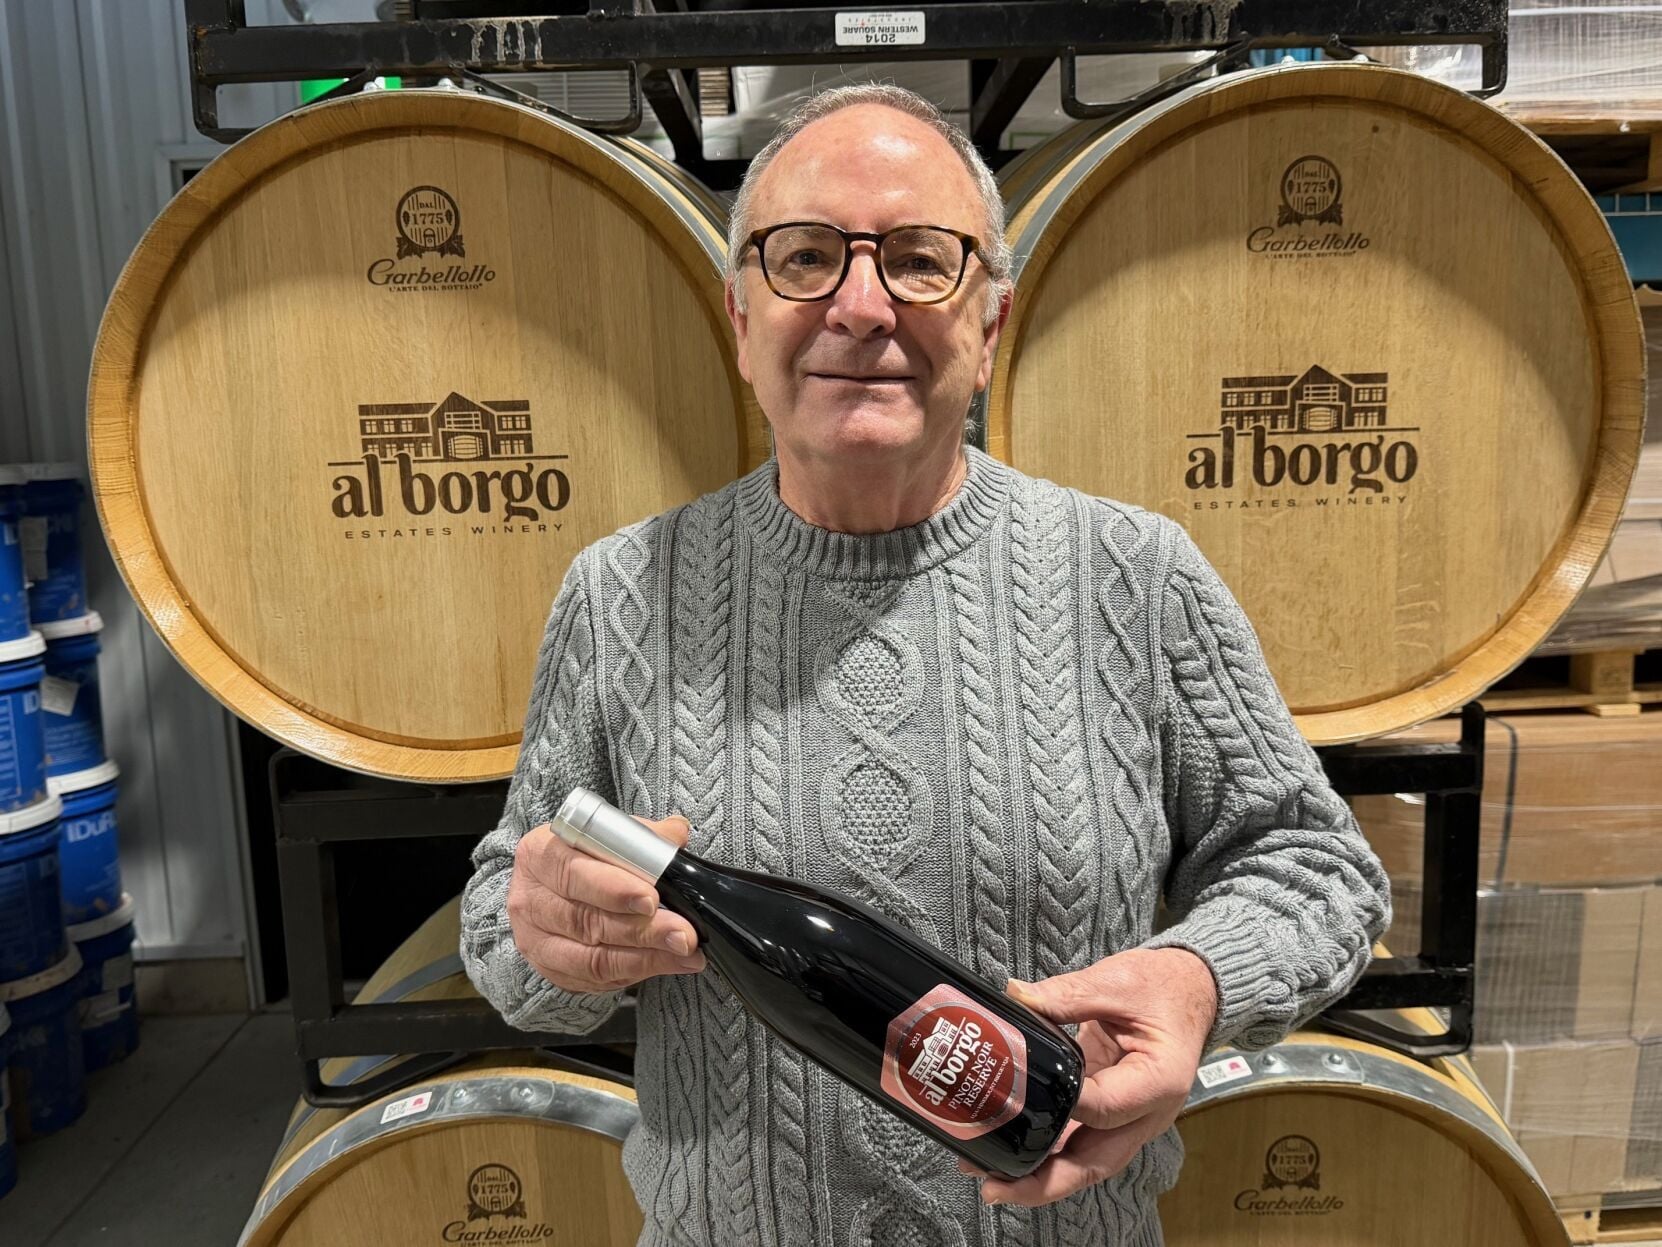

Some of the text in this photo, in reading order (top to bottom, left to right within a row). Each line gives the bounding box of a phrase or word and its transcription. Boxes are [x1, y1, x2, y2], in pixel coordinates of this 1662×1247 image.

[843, 26, 876, 34] SQUARE
[866, 34, 896, 43] 2014
[1296, 182, 1327, 194] 1775
[412, 213, 444, 225] 1775
[1185, 425, 1418, 494] al borgo
[331, 452, 570, 522] al borgo
[1194, 495, 1407, 510] ESTATES WINERY
[345, 524, 563, 539] ESTATES WINERY
[909, 1032, 922, 1049] 2023
[925, 1022, 982, 1106] al borgo
[948, 1041, 994, 1110] PINOT NOIR
[963, 1056, 997, 1107] RESERVE
[481, 1184, 508, 1194] 1775
